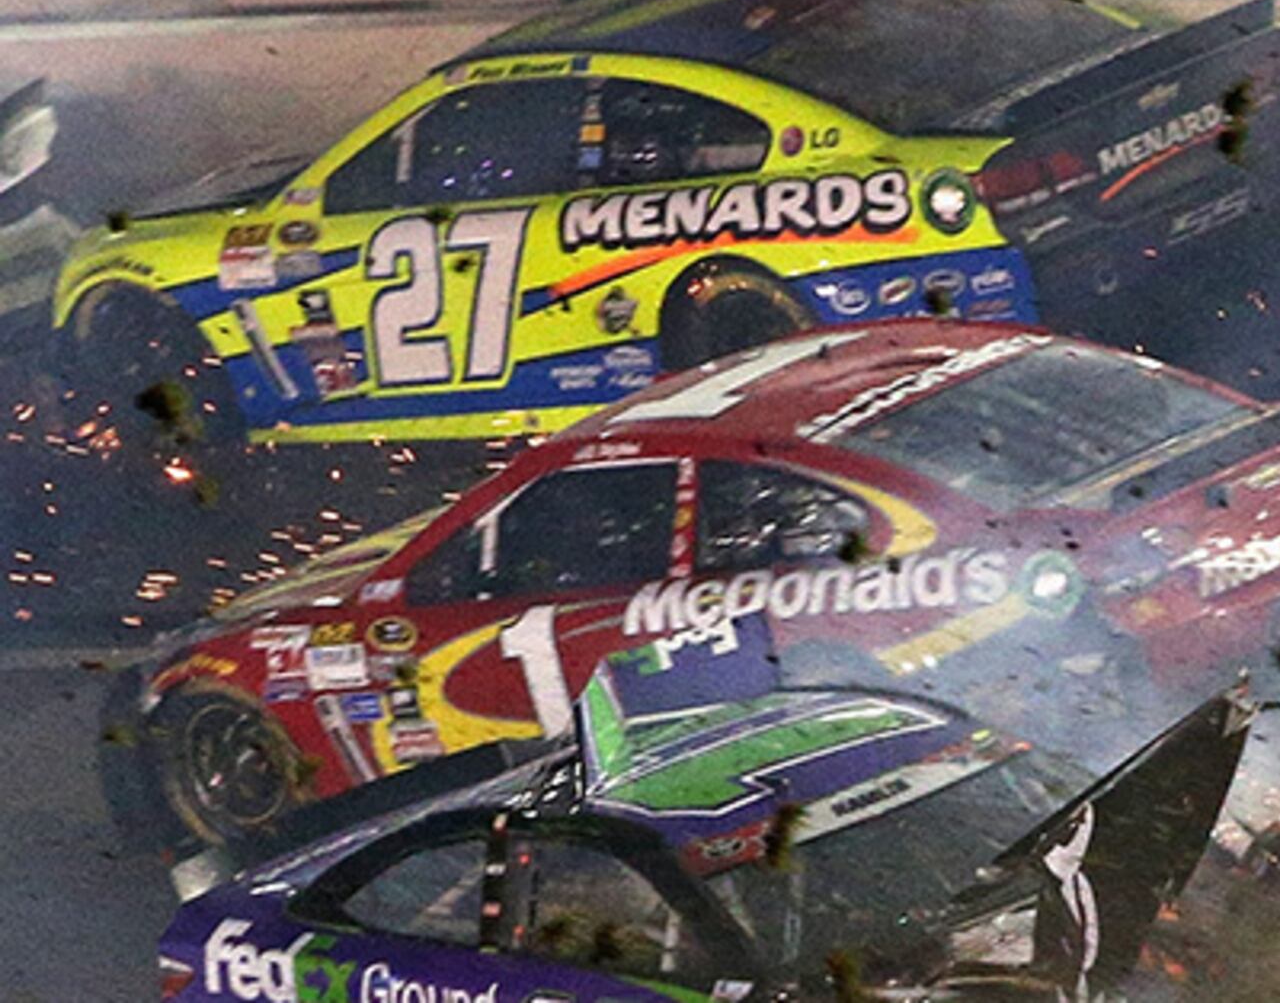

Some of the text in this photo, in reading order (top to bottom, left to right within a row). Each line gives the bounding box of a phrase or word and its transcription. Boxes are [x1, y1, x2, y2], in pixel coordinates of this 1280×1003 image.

[1096, 101, 1238, 175] MENARD
[561, 170, 912, 252] MENARDS
[365, 207, 533, 388] 27
[624, 549, 1006, 636] McDonald's
[502, 605, 574, 740] 1
[206, 918, 358, 1003] FedEx
